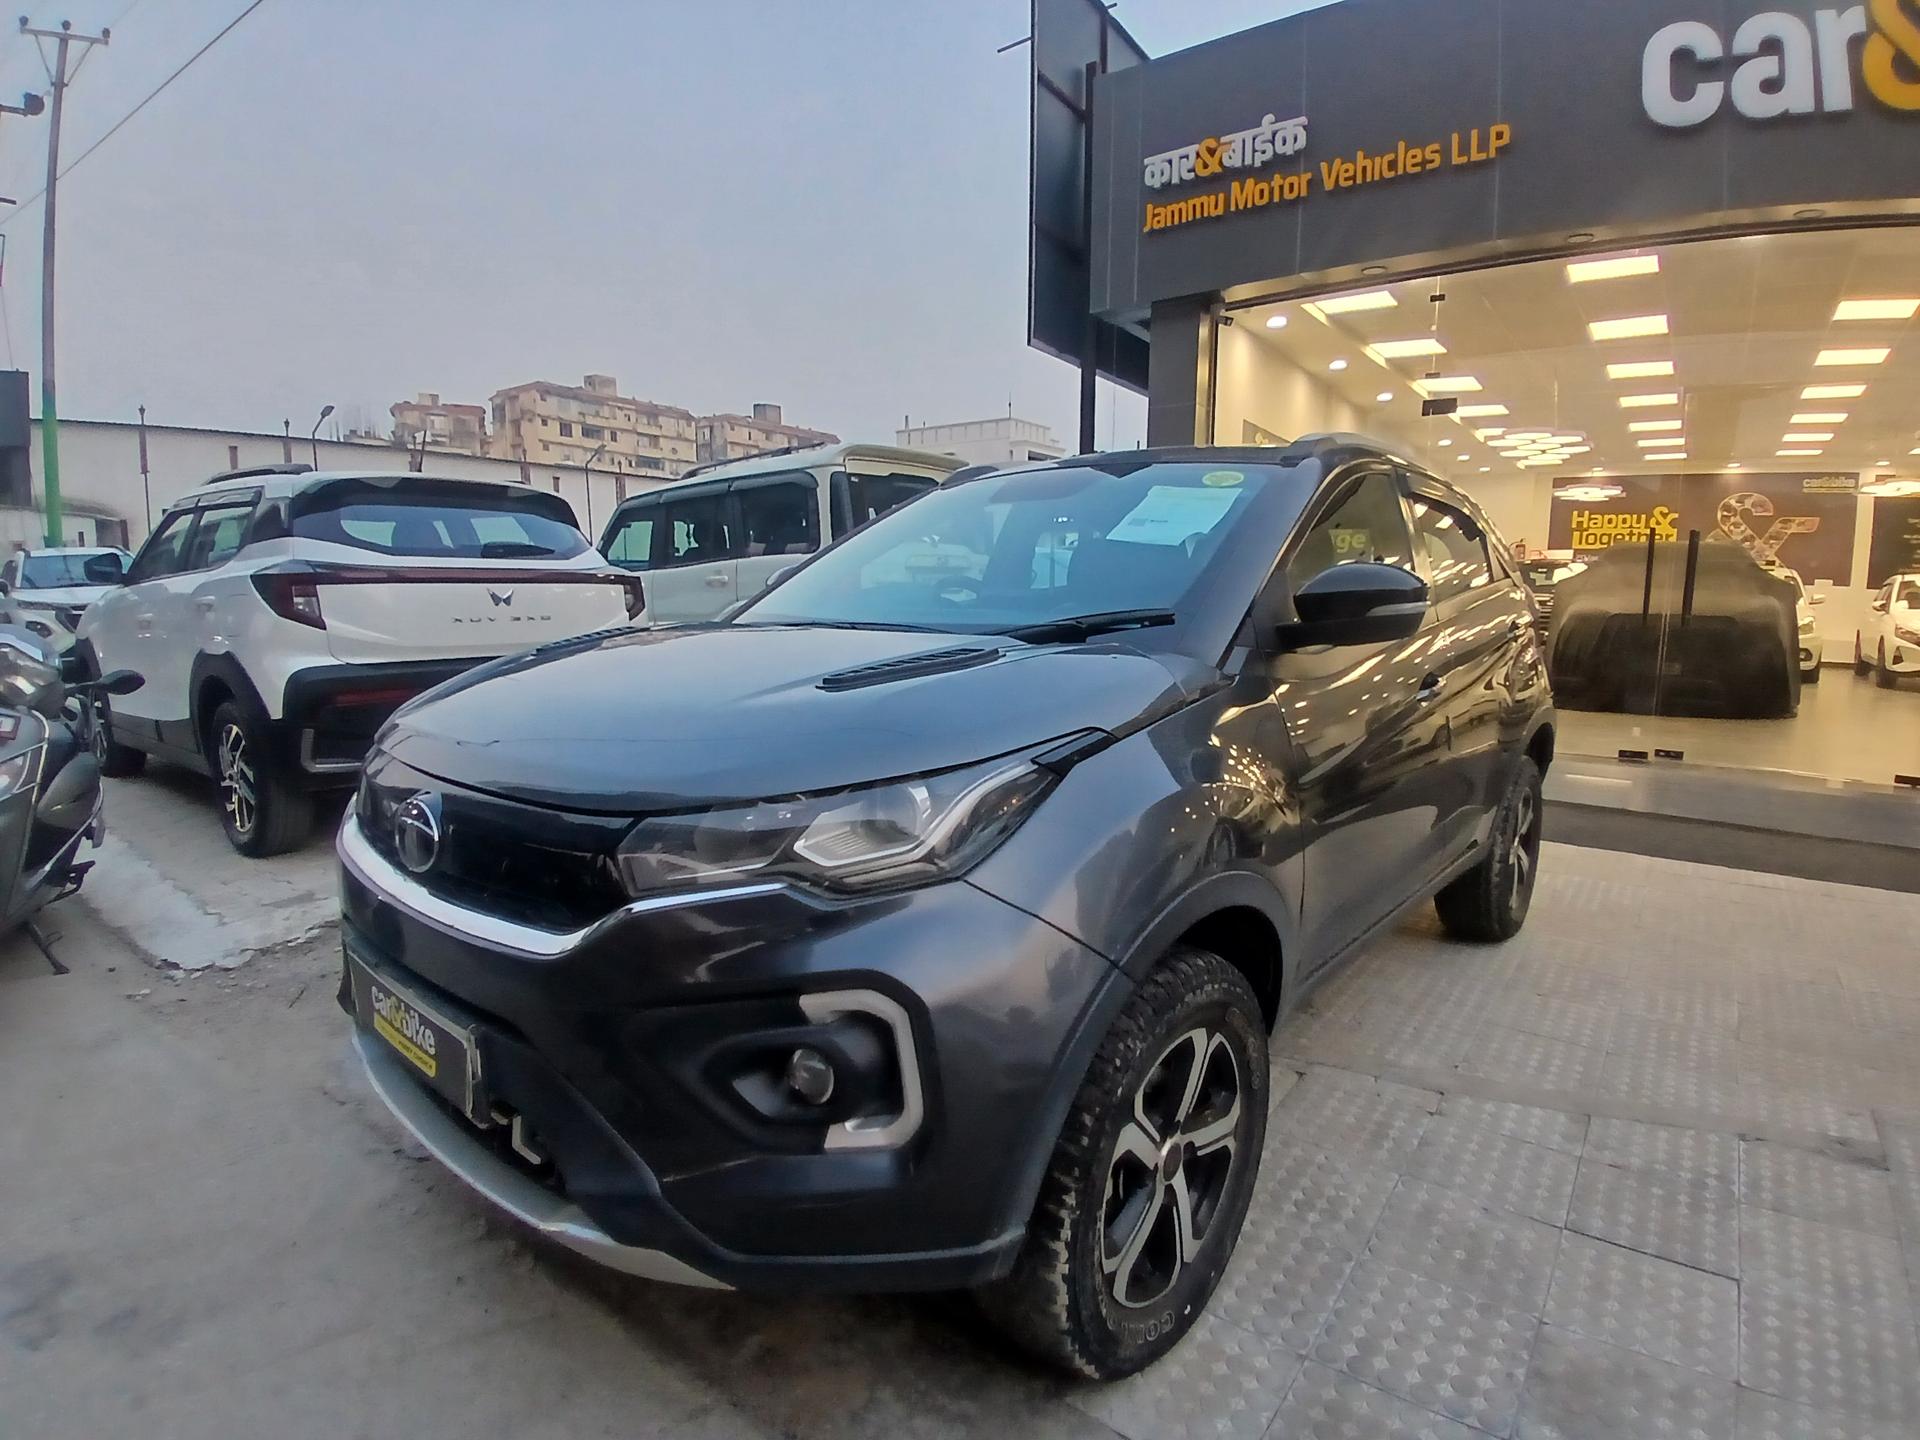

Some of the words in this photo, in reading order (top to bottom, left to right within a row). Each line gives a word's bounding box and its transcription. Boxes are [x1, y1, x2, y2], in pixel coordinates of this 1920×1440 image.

[1142, 192, 1226, 233] Jammu
[1229, 171, 1313, 212] Motor
[1319, 139, 1442, 192] Vehicles
[1450, 123, 1512, 166] LLP
[1571, 510, 1647, 530] Happy
